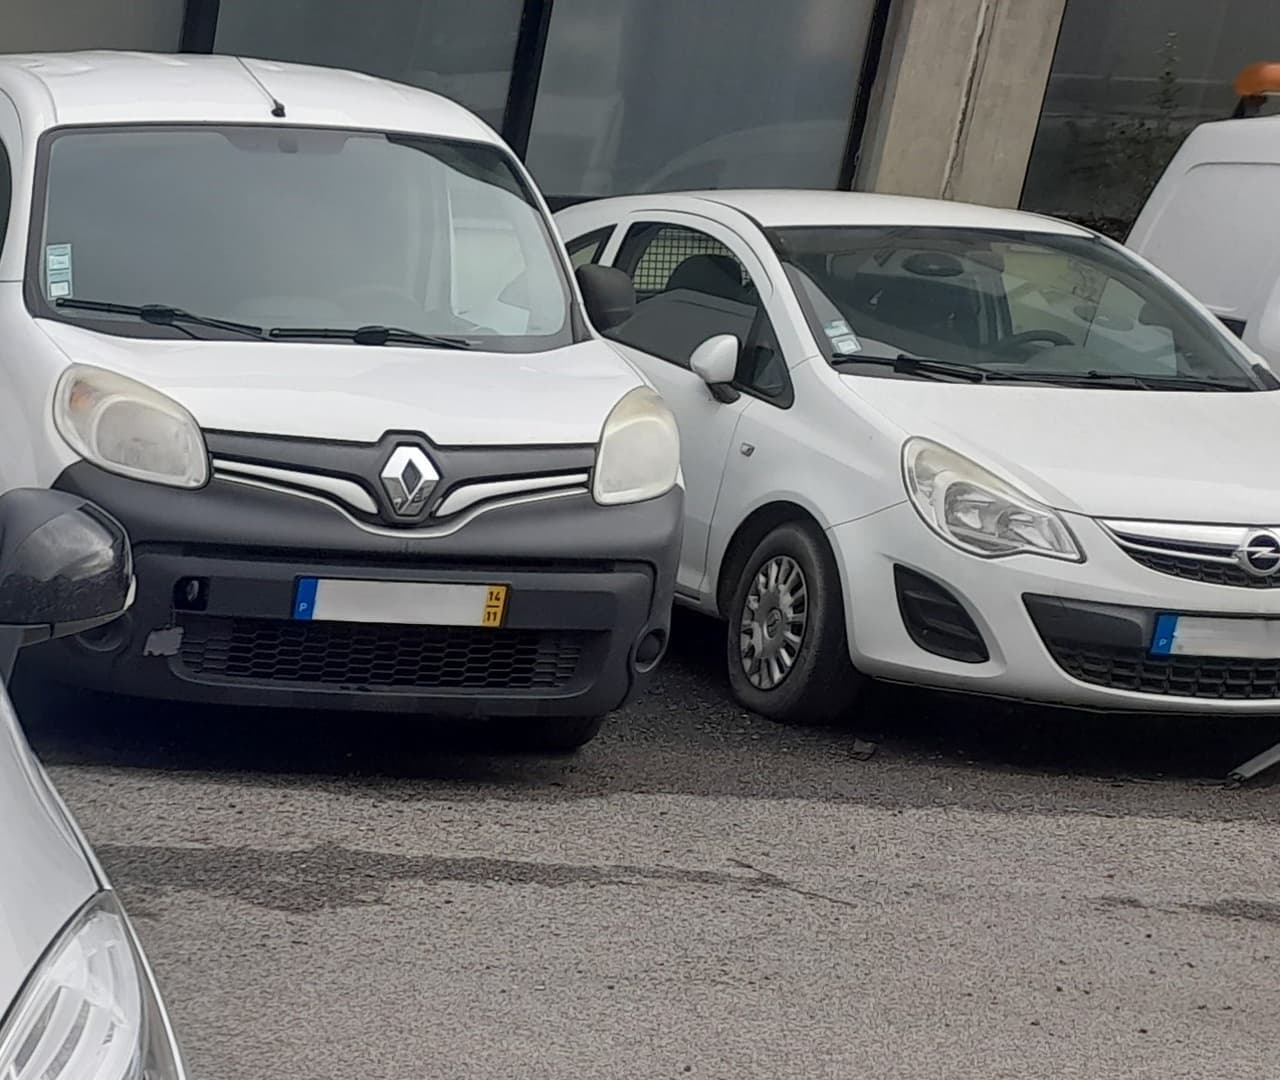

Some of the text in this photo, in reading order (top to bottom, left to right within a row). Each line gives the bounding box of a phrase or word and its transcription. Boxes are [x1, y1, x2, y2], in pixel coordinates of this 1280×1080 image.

[488, 591, 501, 602] 14
[299, 602, 309, 612] P
[486, 611, 498, 623] 11
